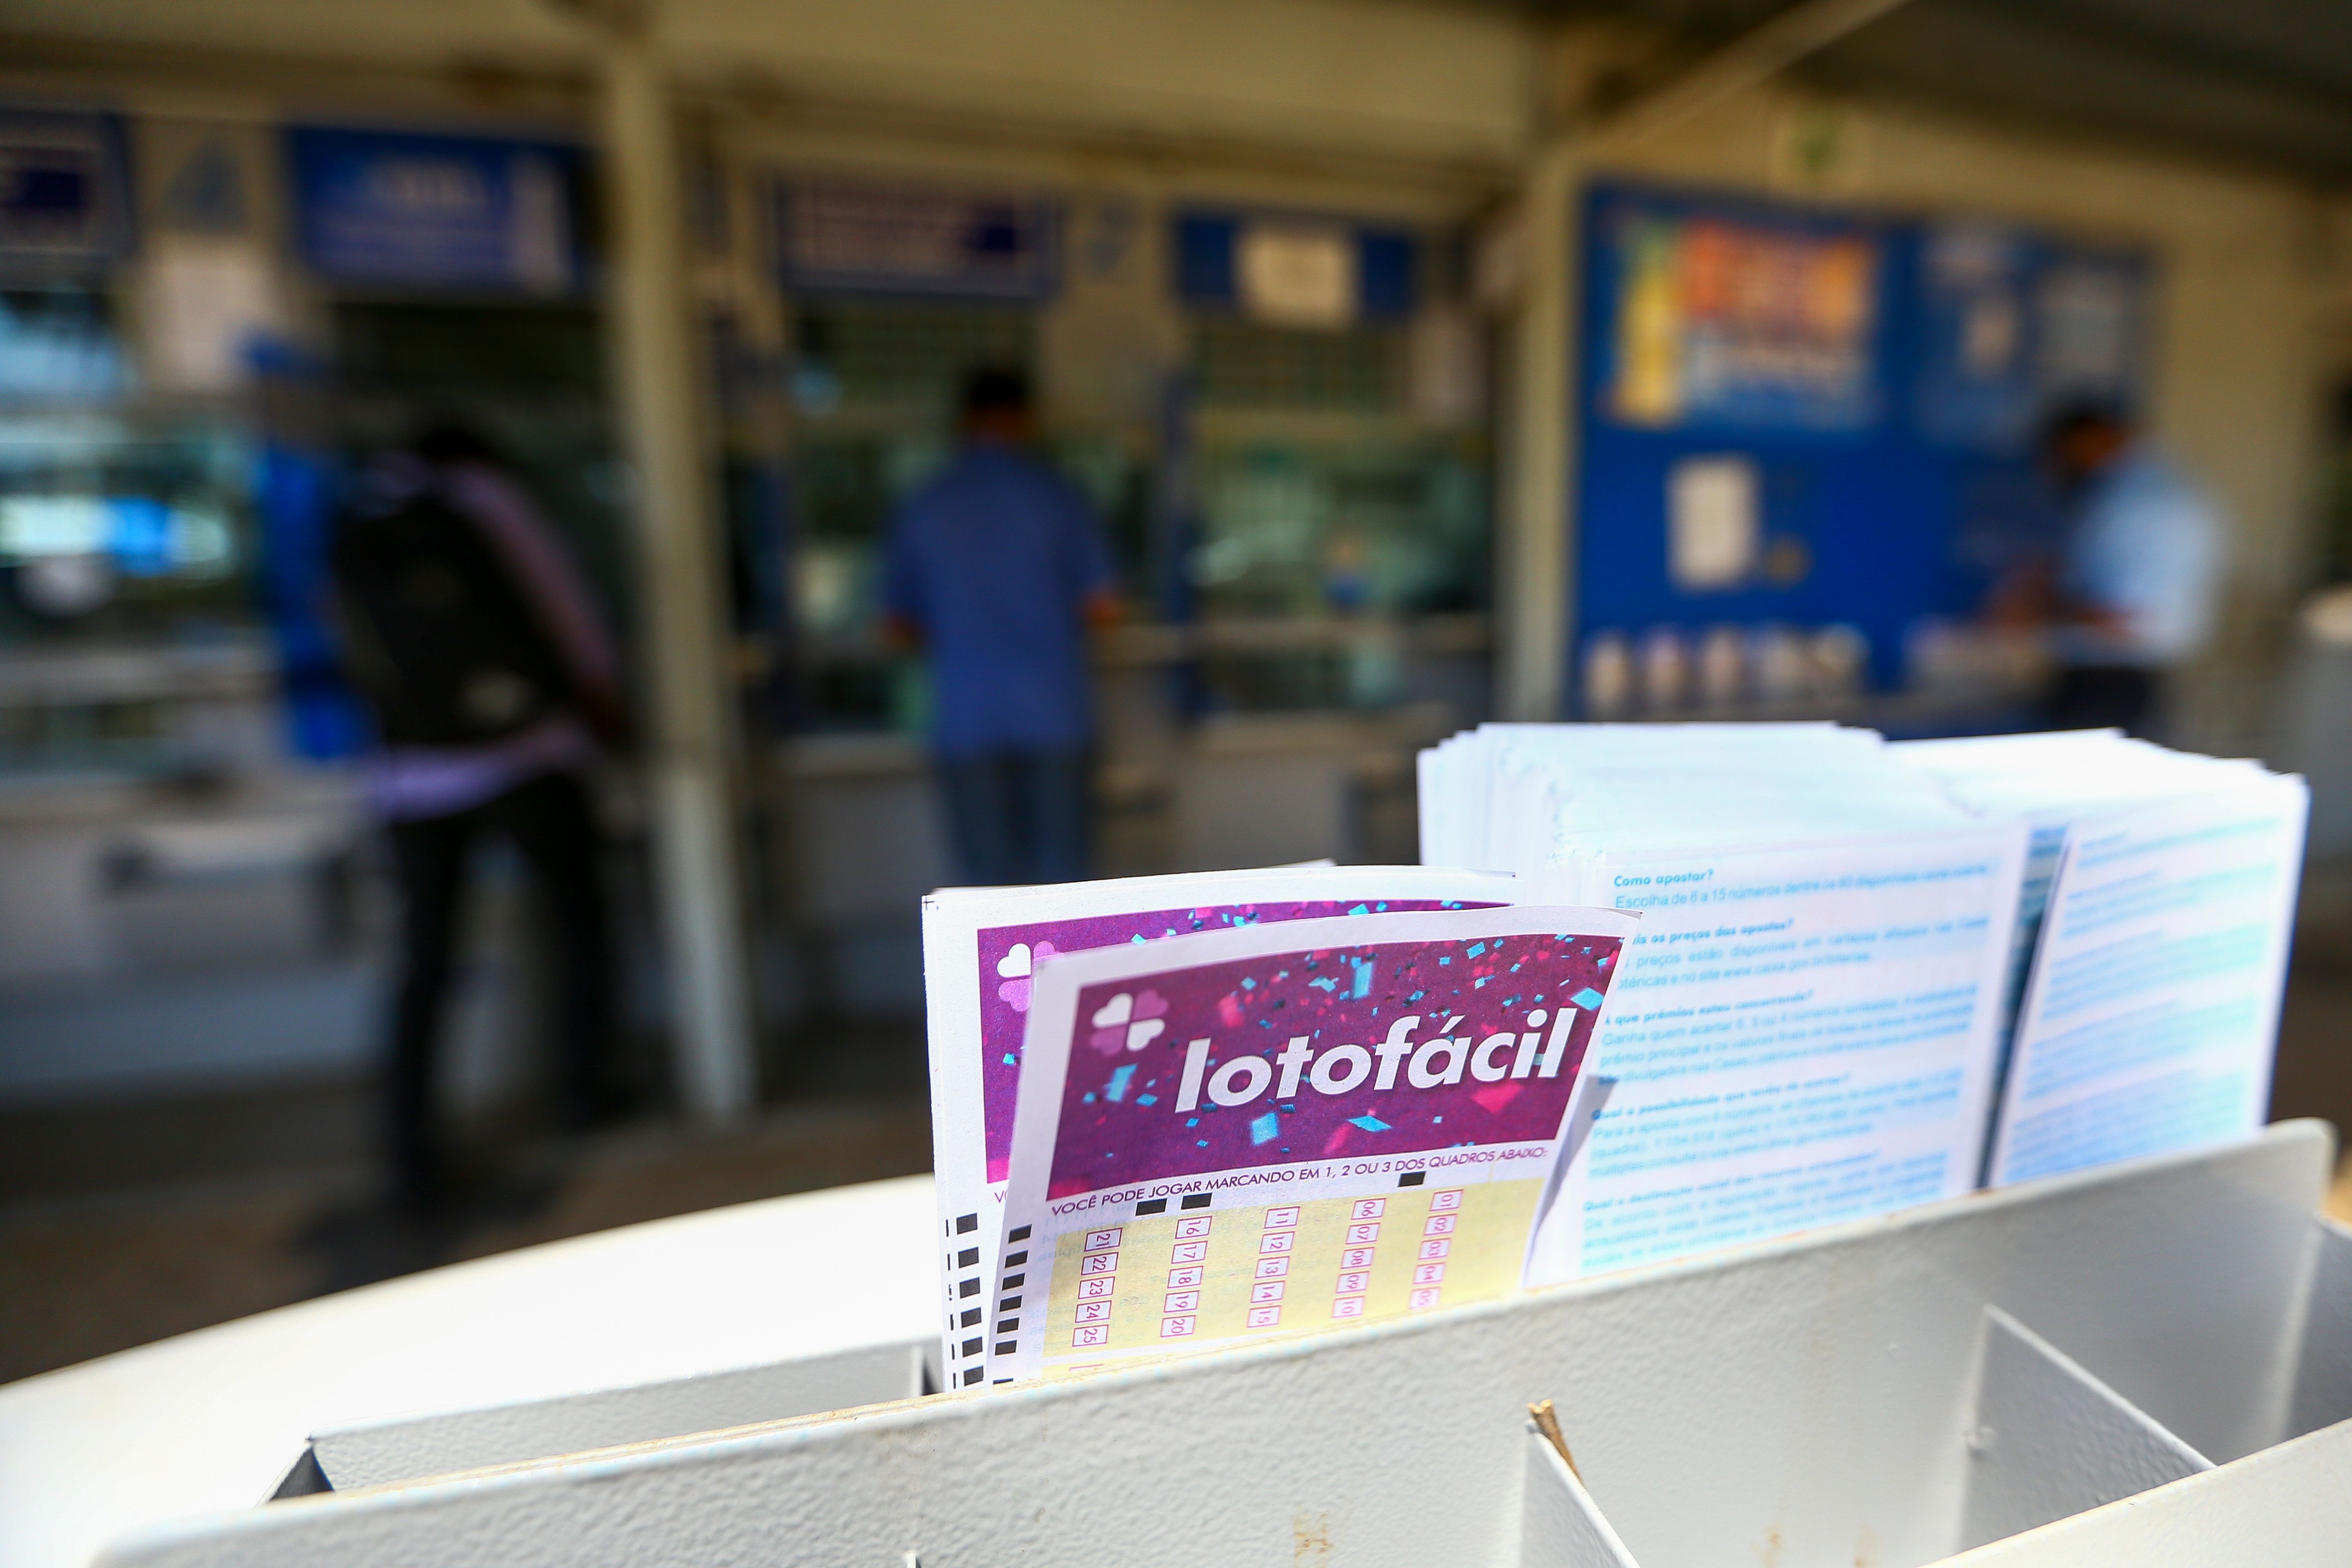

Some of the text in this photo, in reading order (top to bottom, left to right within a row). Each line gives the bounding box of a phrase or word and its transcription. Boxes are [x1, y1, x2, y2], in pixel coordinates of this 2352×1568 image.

[1614, 868, 1714, 887] Como apostar?
[1616, 892, 1668, 908] Escolha
[1672, 891, 1687, 903] de
[1690, 890, 1697, 902] 6
[1700, 892, 1708, 902] a
[1713, 888, 1726, 901] 15
[1726, 885, 1781, 899] números
[1651, 935, 1665, 944] os
[1670, 931, 1710, 945] preços
[1715, 926, 1736, 937] das
[1637, 955, 1681, 970] preços
[1689, 947, 1723, 962] estão
[1615, 1014, 1639, 1026] que
[1644, 1008, 1694, 1023] prêmios
[1602, 1031, 1646, 1046] Ganha
[1651, 1029, 1686, 1042] quem
[1174, 1006, 1578, 1114] lotofácil
[1600, 1052, 1644, 1068] prêmio
[1052, 1147, 1548, 1216] VOCÊ PODE JOGAR MARCANDO EM 1, 2 OU 3 DOS QUADROS ABAIXO:
